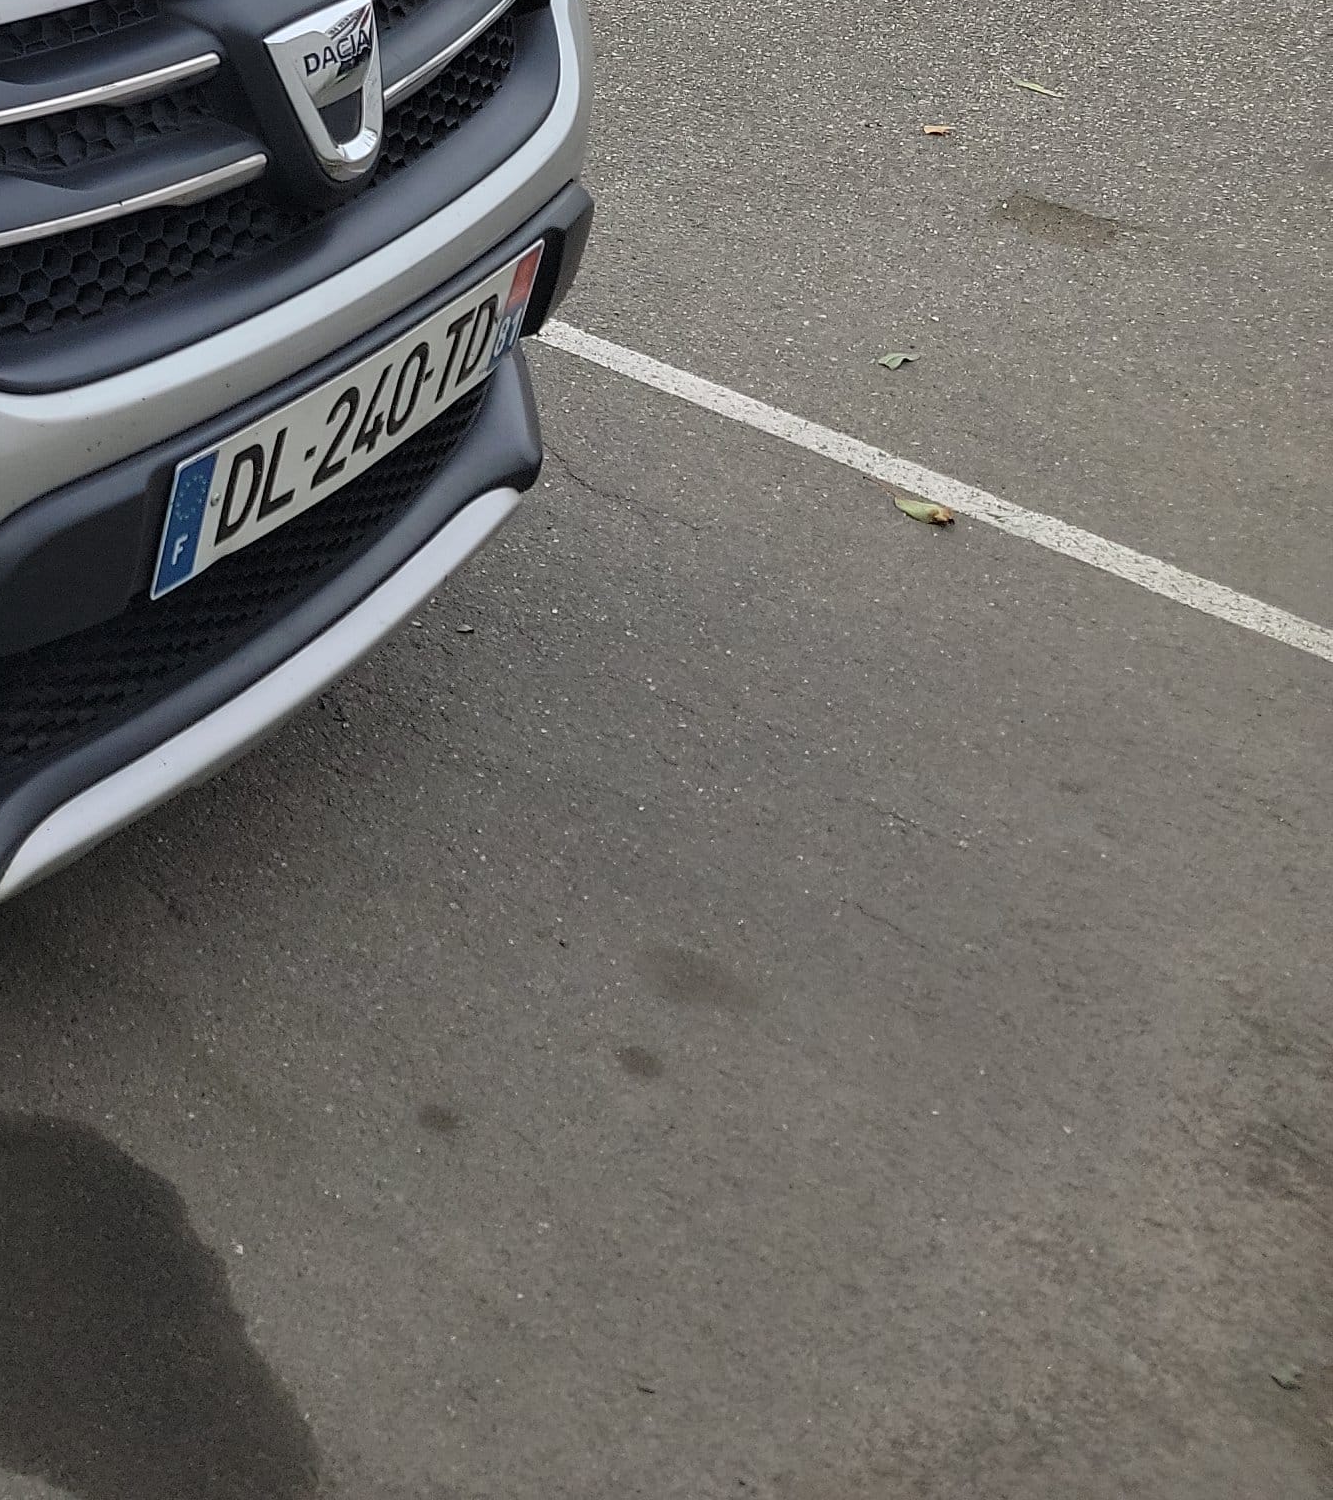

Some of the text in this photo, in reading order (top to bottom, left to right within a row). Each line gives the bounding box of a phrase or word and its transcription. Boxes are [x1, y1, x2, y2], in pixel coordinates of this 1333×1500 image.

[303, 29, 373, 77] DACIA
[171, 293, 522, 567] F DL-240-TD 81
